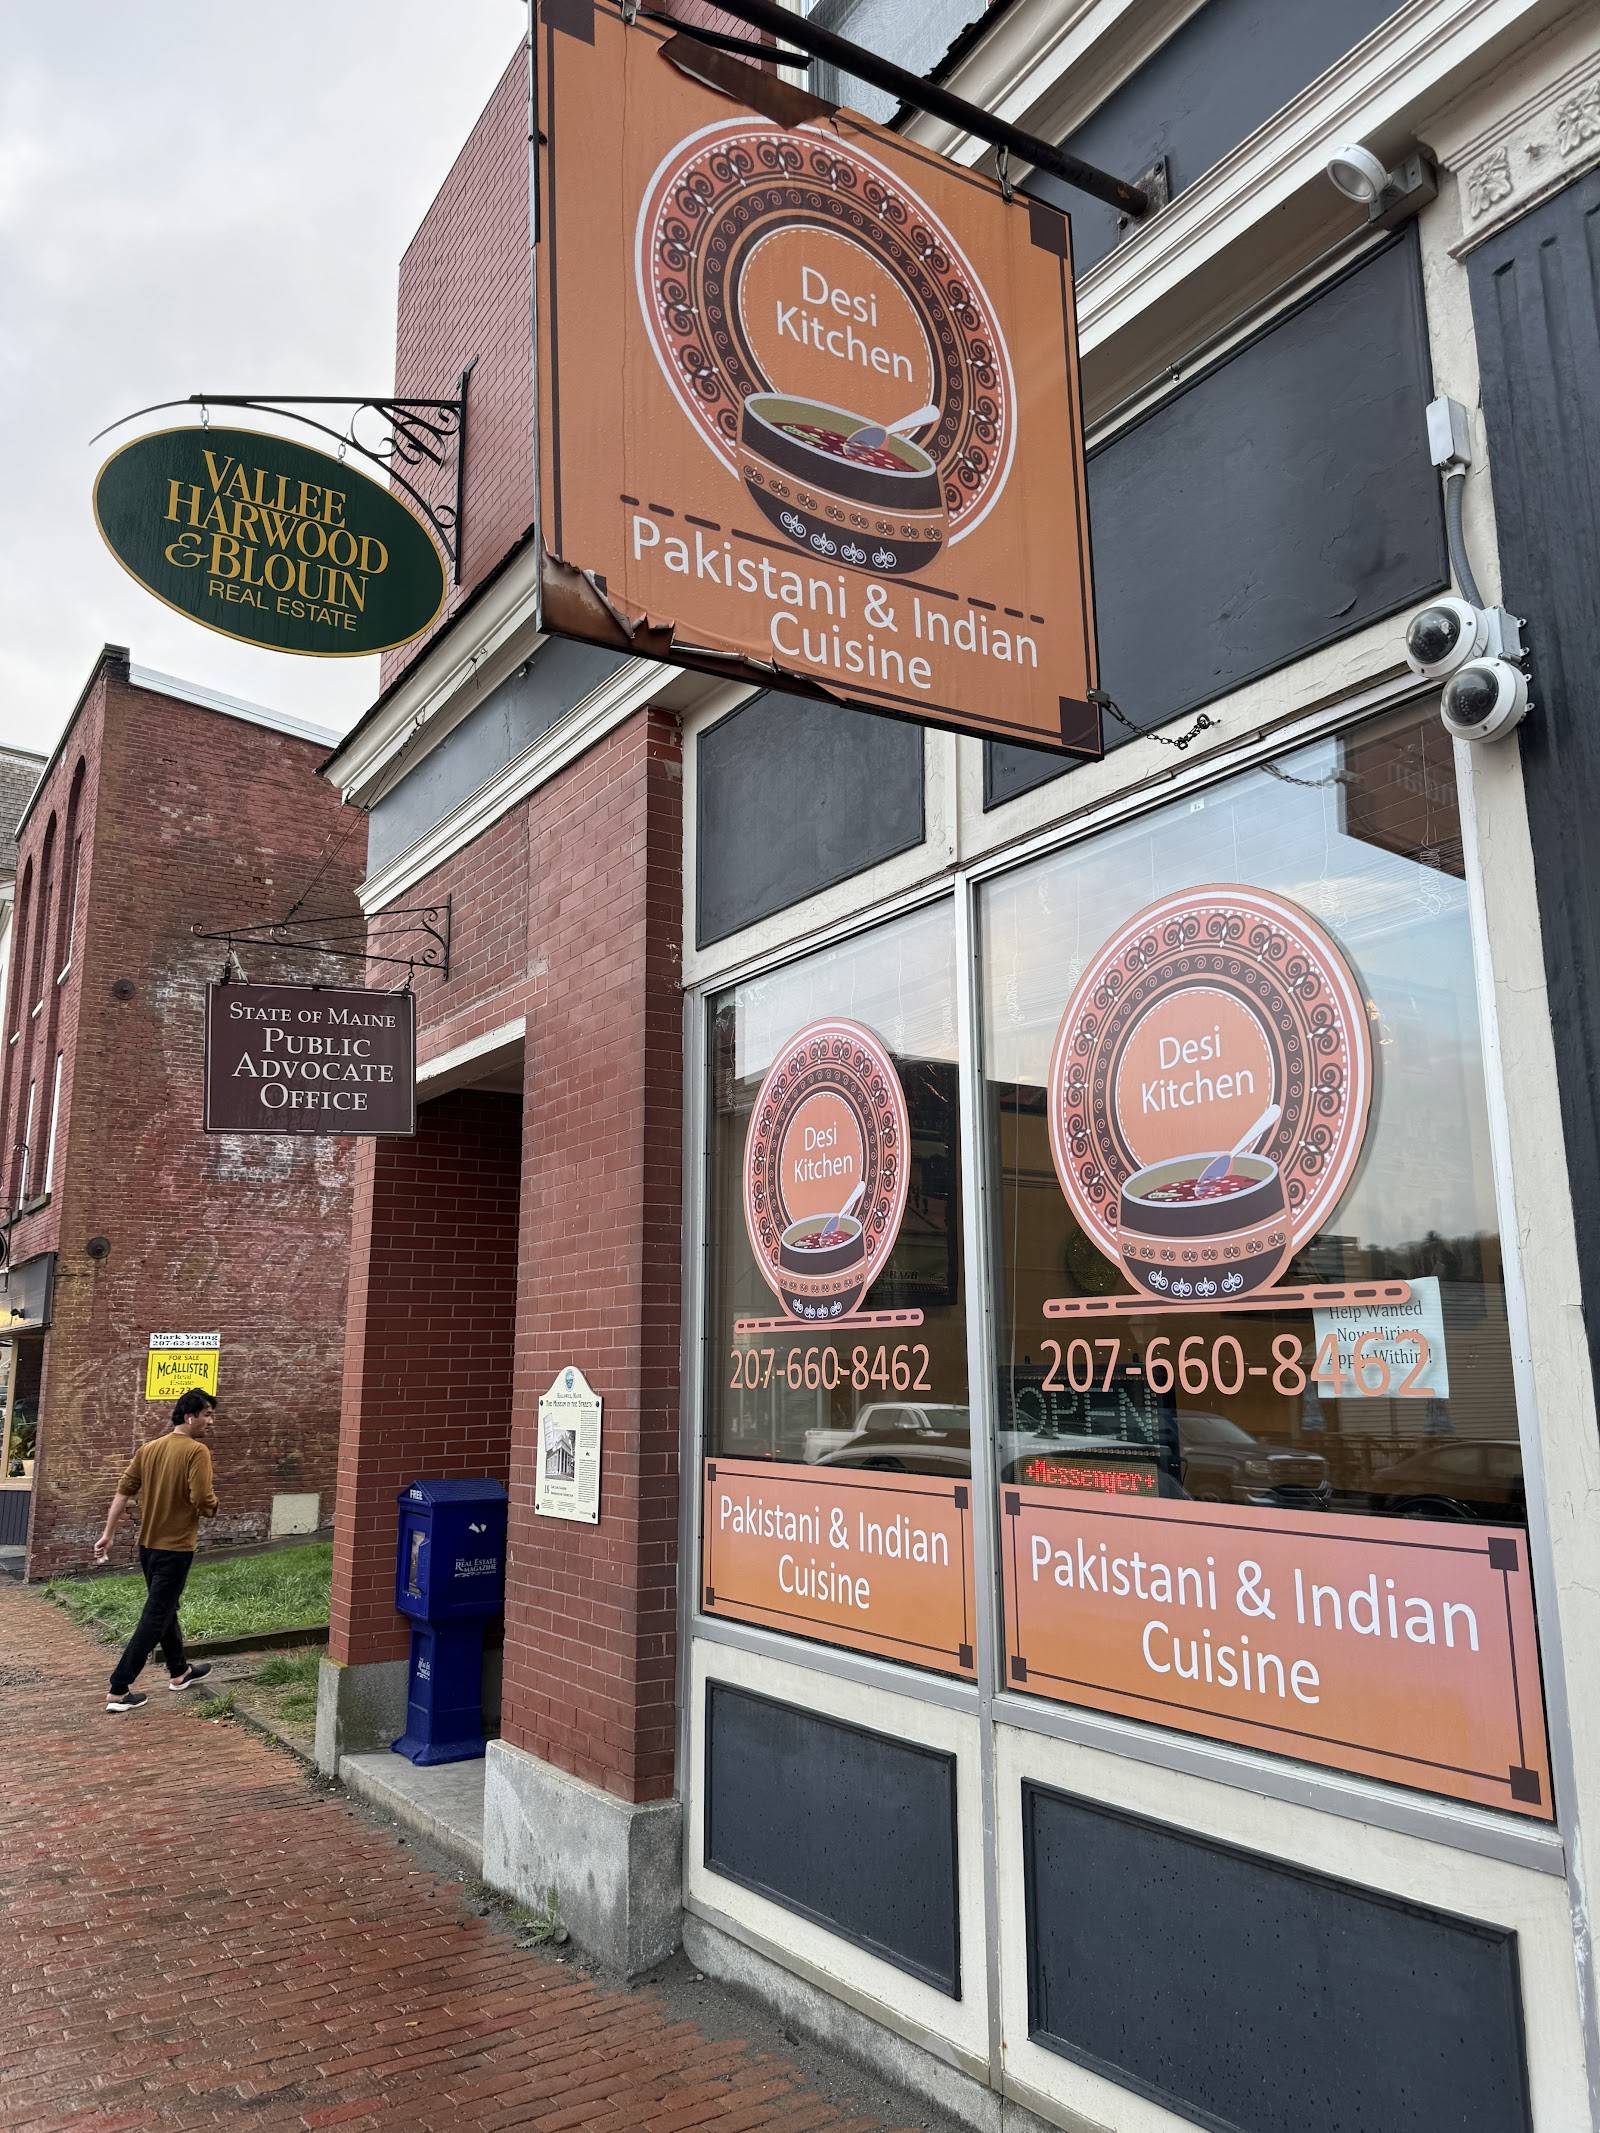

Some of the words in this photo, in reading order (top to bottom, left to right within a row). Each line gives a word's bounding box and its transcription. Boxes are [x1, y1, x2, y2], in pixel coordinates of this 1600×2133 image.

[801, 266, 878, 327] Desi
[776, 300, 914, 383] Kitchen
[202, 449, 347, 528] VALLEE
[164, 479, 389, 574] HARWOOD
[209, 580, 269, 610] REAL
[276, 597, 357, 631] ESTATE
[633, 515, 846, 619] Pakistani
[865, 584, 898, 632] &
[915, 597, 1039, 667] Indian
[769, 613, 932, 689] Cuisine
[232, 1051, 394, 1083] ADVOCATE
[262, 1027, 371, 1057] PUBLIC
[1158, 1025, 1222, 1070] Desi
[260, 1082, 368, 1110] OFFICE
[1141, 1065, 1255, 1114] Kitchen
[804, 1121, 838, 1151] Desi
[793, 1153, 853, 1183] Kitchen
[1329, 1304, 1362, 1322] Help
[1366, 1301, 1423, 1318] Wanted
[729, 1343, 932, 1392] 207-660-8462
[1040, 1331, 1436, 1398] 207-660-8462
[1328, 1352, 1370, 1369] Appy
[159, 1387, 192, 1395] 621-2
[1016, 1386, 1154, 1442] OPEN
[409, 1489, 423, 1500] FREE
[719, 1494, 820, 1545] Pakistani
[829, 1507, 850, 1550] &
[859, 1511, 949, 1567] Indian
[778, 1554, 871, 1610] Cuisine
[1031, 1534, 1218, 1610] Pakistani
[1236, 1560, 1276, 1620] &
[1295, 1568, 1480, 1652] Indian
[1142, 1619, 1320, 1705] Cuisine
